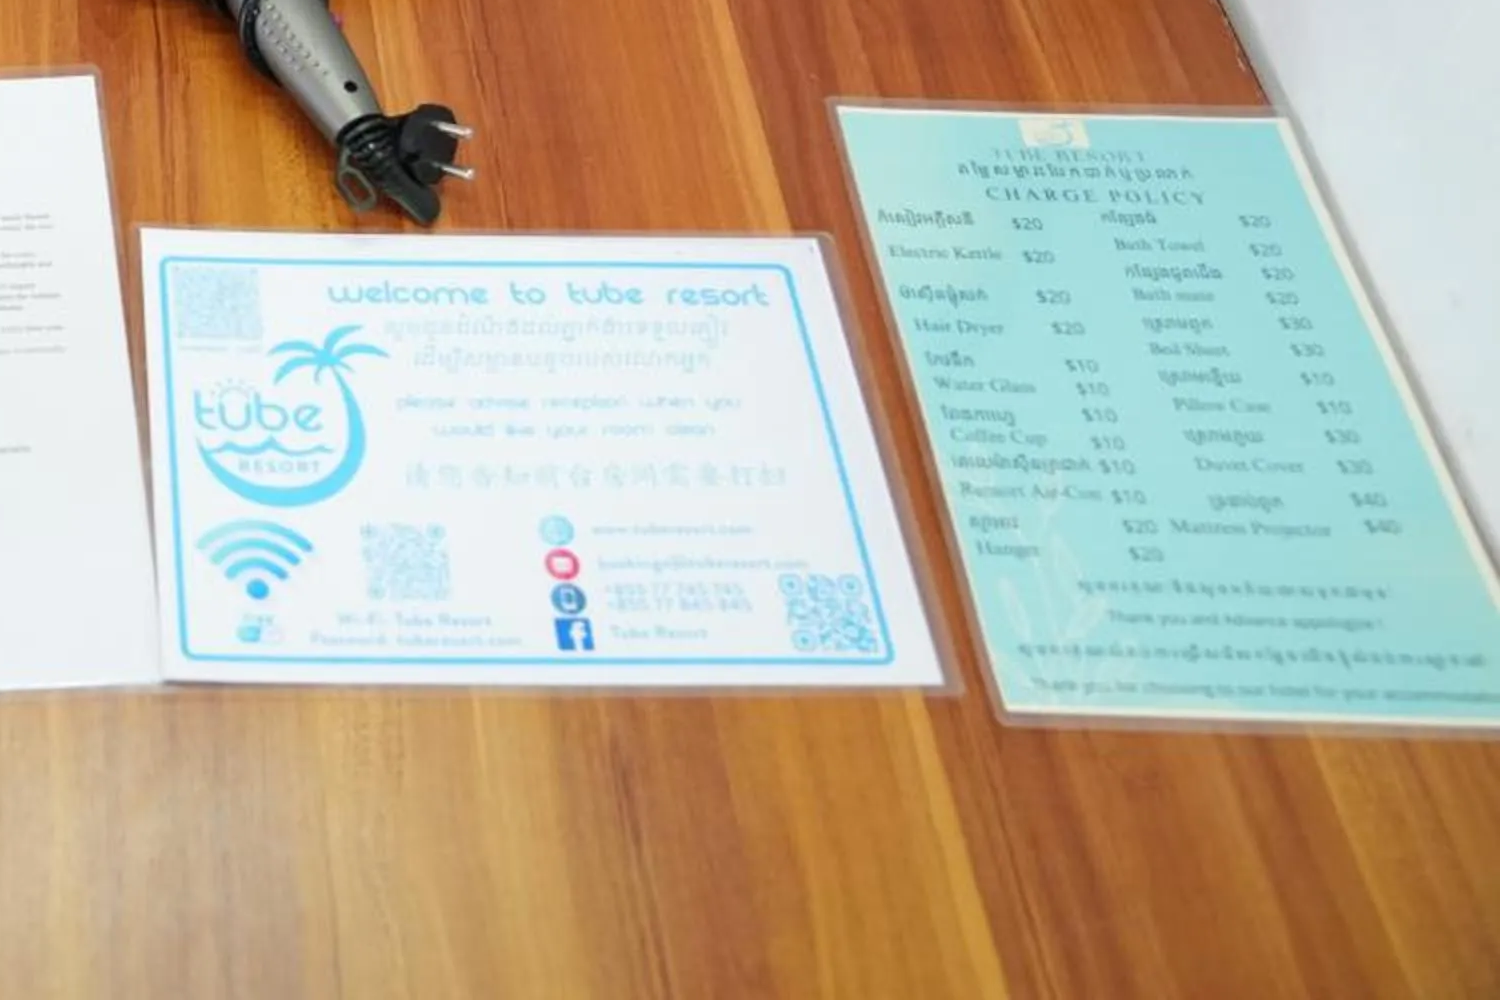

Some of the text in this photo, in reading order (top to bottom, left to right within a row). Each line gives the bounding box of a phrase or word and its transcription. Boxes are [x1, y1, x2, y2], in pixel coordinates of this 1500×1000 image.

[985, 186, 1206, 206] CHARGE POLICY
[1011, 216, 1044, 231] $20
[1238, 214, 1271, 229] $20
[1022, 251, 1056, 264] $20
[1249, 243, 1283, 258] $20
[1260, 266, 1295, 281] $20
[326, 279, 770, 308] welcome to tube resort
[1035, 289, 1071, 305] $20
[1265, 291, 1300, 305] $20
[1051, 321, 1086, 336] $20
[1278, 316, 1313, 331] $30
[1289, 341, 1325, 357] $30
[1065, 358, 1100, 374] $10
[1300, 371, 1336, 387] $10
[1075, 381, 1110, 397] $10
[193, 389, 324, 432] tube
[1081, 407, 1118, 424] $10
[1316, 400, 1353, 415] $10
[1091, 434, 1126, 451] $10
[1324, 428, 1362, 445] $30
[238, 459, 320, 475] RESORT
[1098, 457, 1136, 475] $10
[1335, 458, 1374, 475] $30
[1110, 488, 1148, 505] $10
[1348, 491, 1388, 508] $40
[1121, 518, 1159, 535] $20
[1127, 545, 1165, 562] $20
